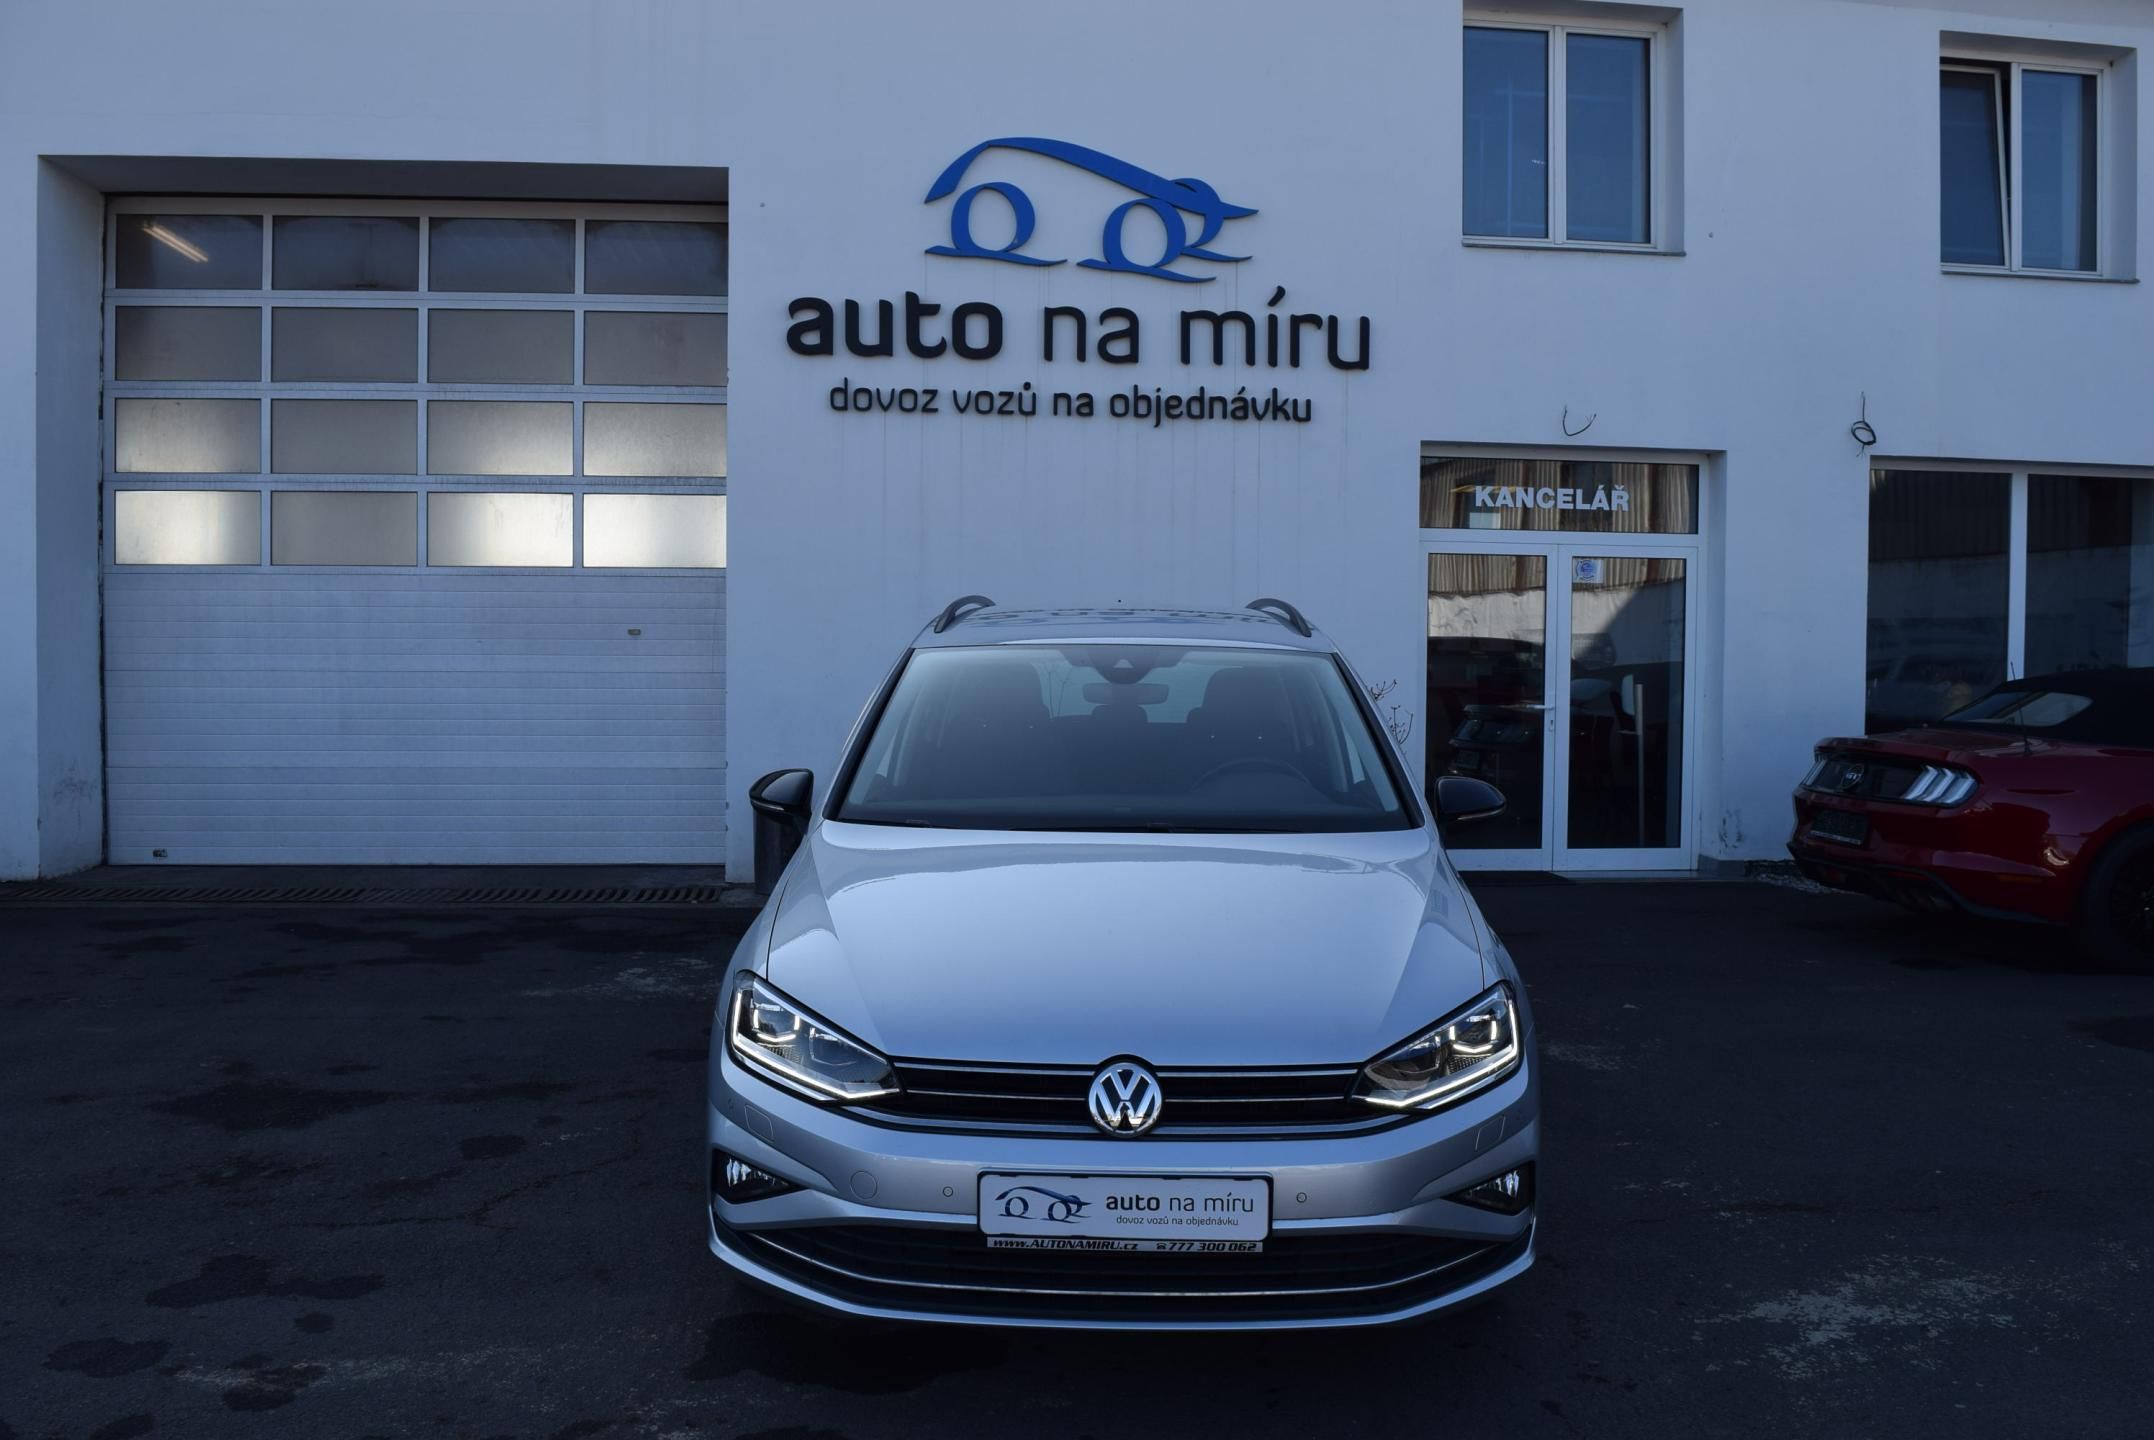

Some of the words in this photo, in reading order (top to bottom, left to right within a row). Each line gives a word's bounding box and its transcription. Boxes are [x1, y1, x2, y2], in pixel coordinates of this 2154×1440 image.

[786, 291, 1004, 362] auto
[1043, 305, 1140, 366] na
[1180, 284, 1372, 372] míru
[829, 376, 939, 417] dovoz
[952, 381, 1037, 418] vozů
[1052, 392, 1095, 418] na
[1109, 385, 1313, 429] objednávku
[1474, 484, 1631, 512] KANCELÁŘ
[1105, 1195, 1161, 1212] auto
[1169, 1197, 1195, 1212] na
[1204, 1191, 1254, 1213] míru
[1116, 1214, 1145, 1225] dovoz
[1146, 1215, 1169, 1225] vozů
[1171, 1217, 1183, 1225] na
[1185, 1215, 1239, 1227] objednávku
[992, 1239, 1138, 1251] www.AUTONAMIRU.cz
[1198, 1243, 1226, 1252] 300
[1228, 1243, 1257, 1252] 062
